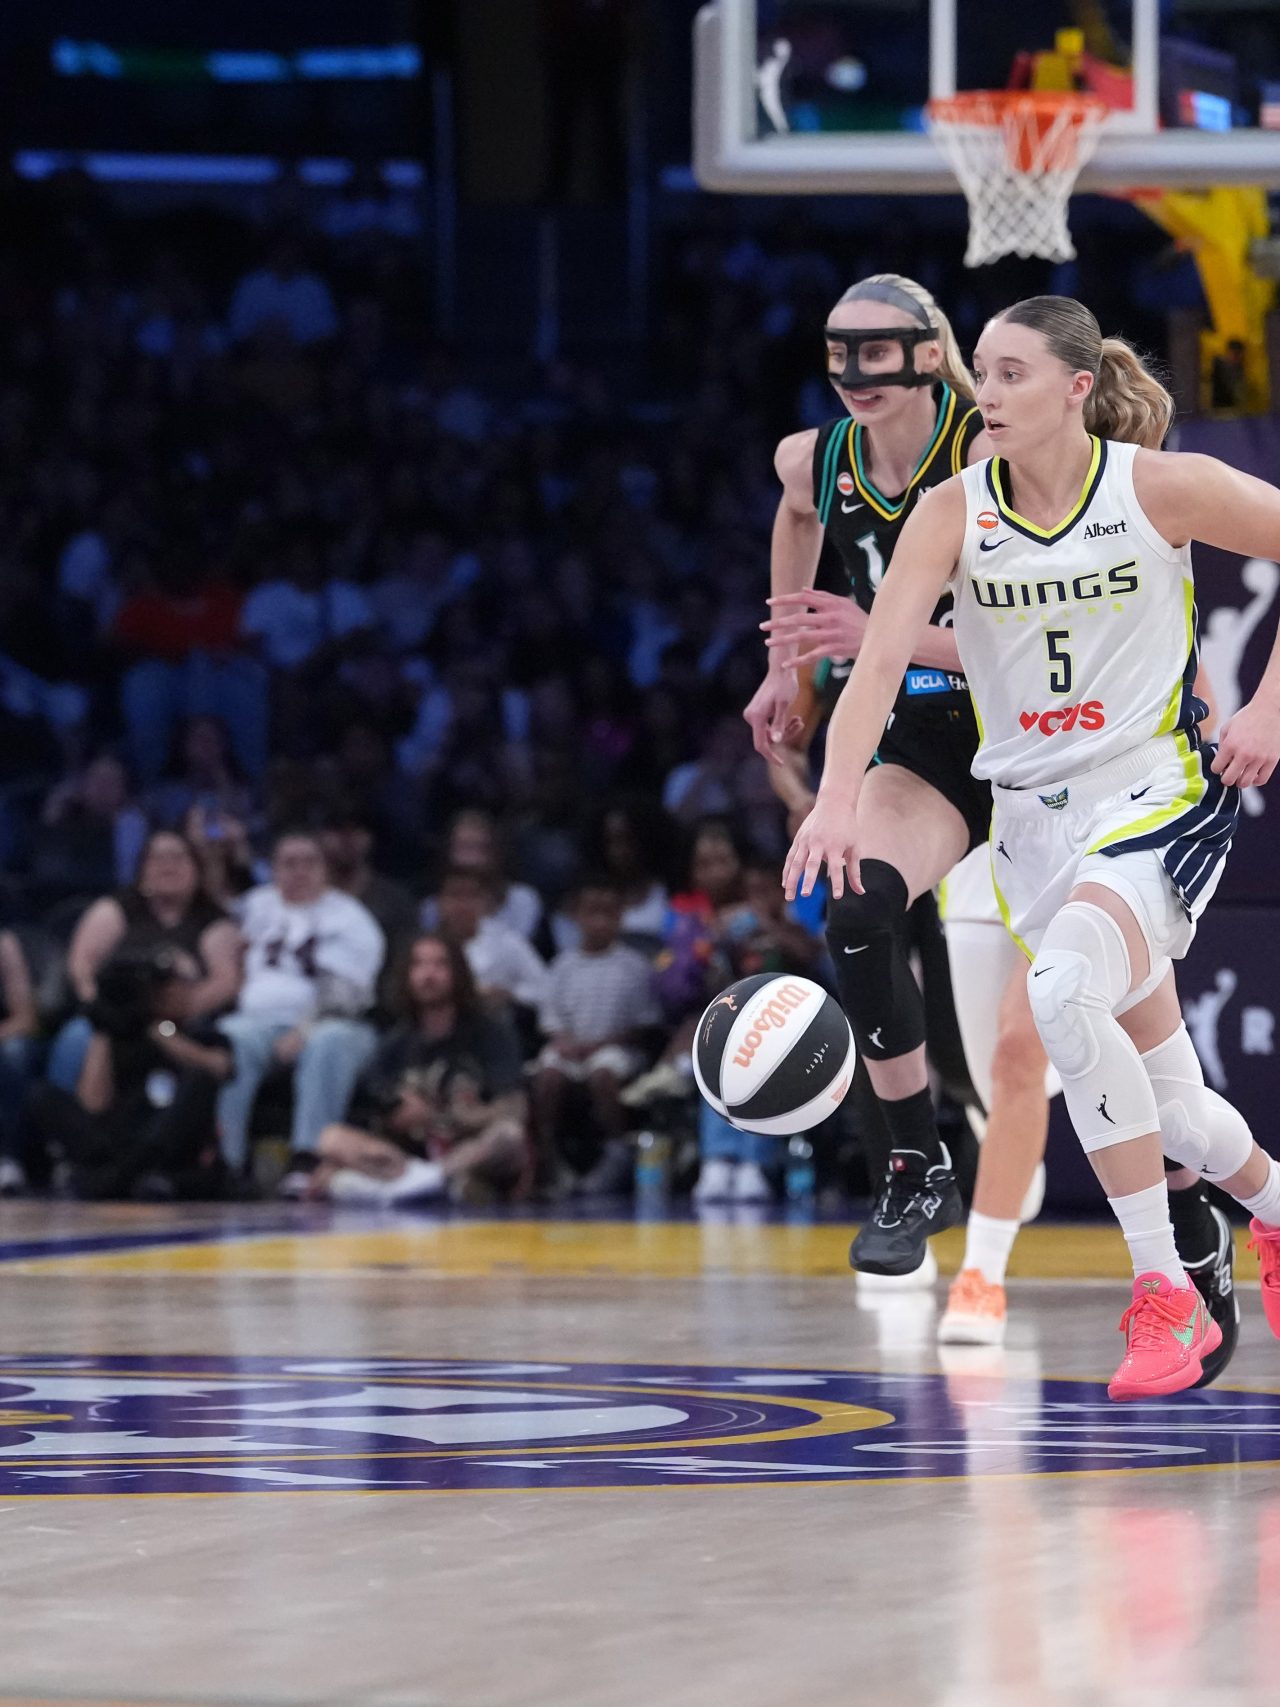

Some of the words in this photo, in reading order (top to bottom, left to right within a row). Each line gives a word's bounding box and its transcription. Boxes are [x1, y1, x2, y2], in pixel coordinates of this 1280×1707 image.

[1083, 519, 1127, 540] Albert
[1046, 630, 1073, 694] 5
[911, 676, 944, 690] UCLA
[1038, 700, 1106, 737] CVS
[732, 984, 812, 1069] Wilson
